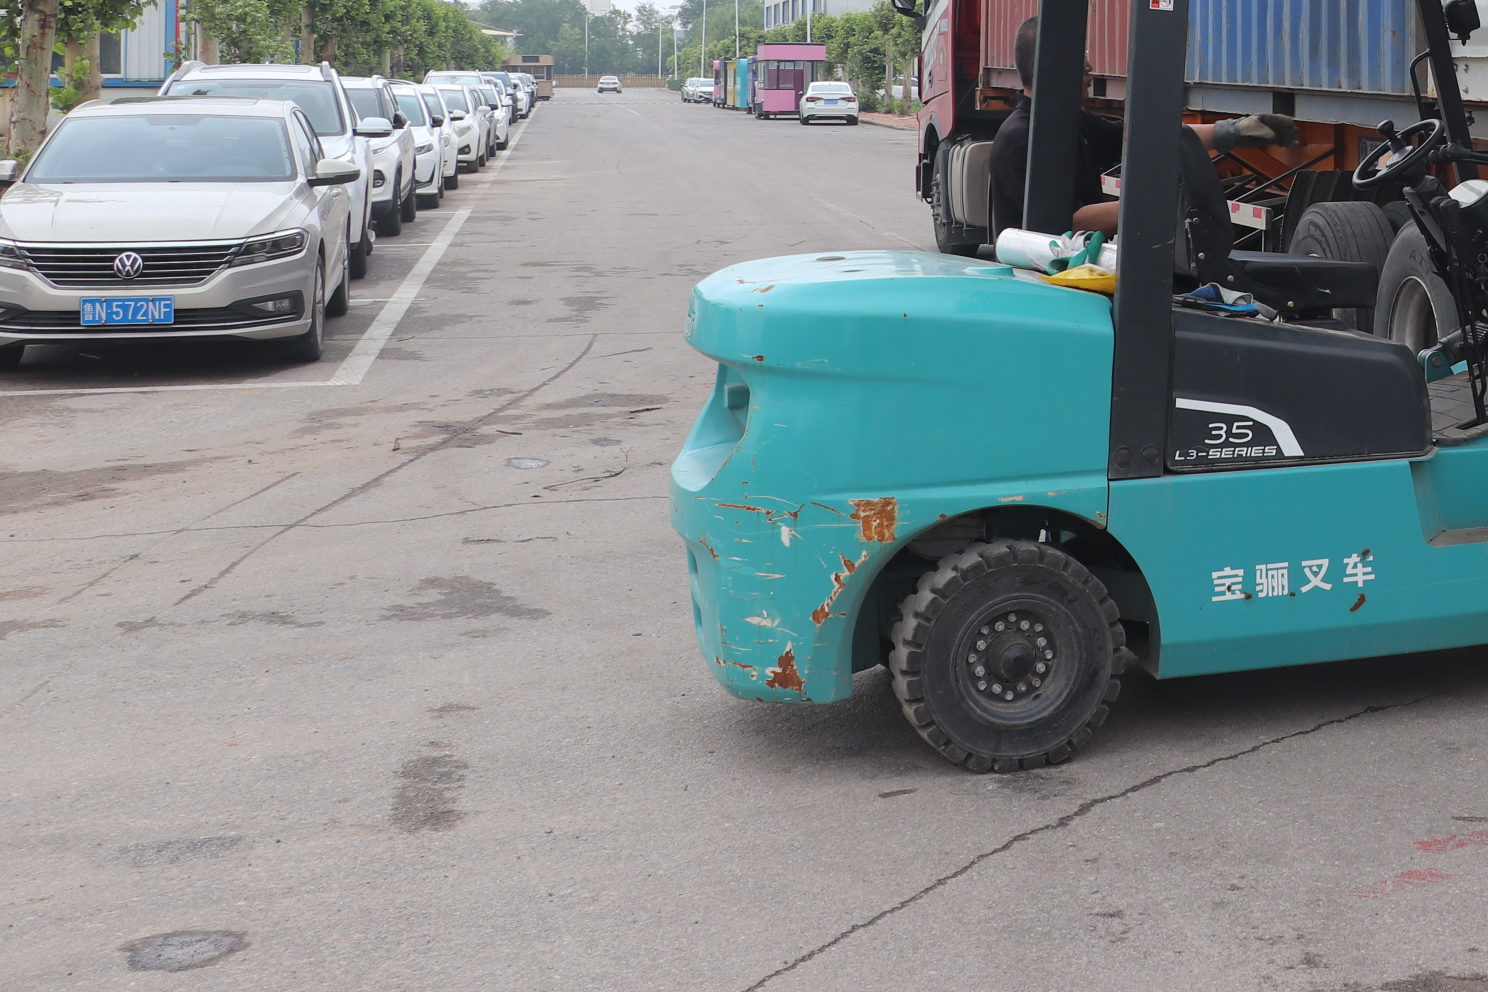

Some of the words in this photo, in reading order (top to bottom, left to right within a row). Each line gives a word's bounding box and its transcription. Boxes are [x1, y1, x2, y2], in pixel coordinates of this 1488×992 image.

[1204, 421, 1254, 444] 35
[1174, 445, 1278, 461] L3-SERIES
[1211, 553, 1376, 602] 宝骊叉车
